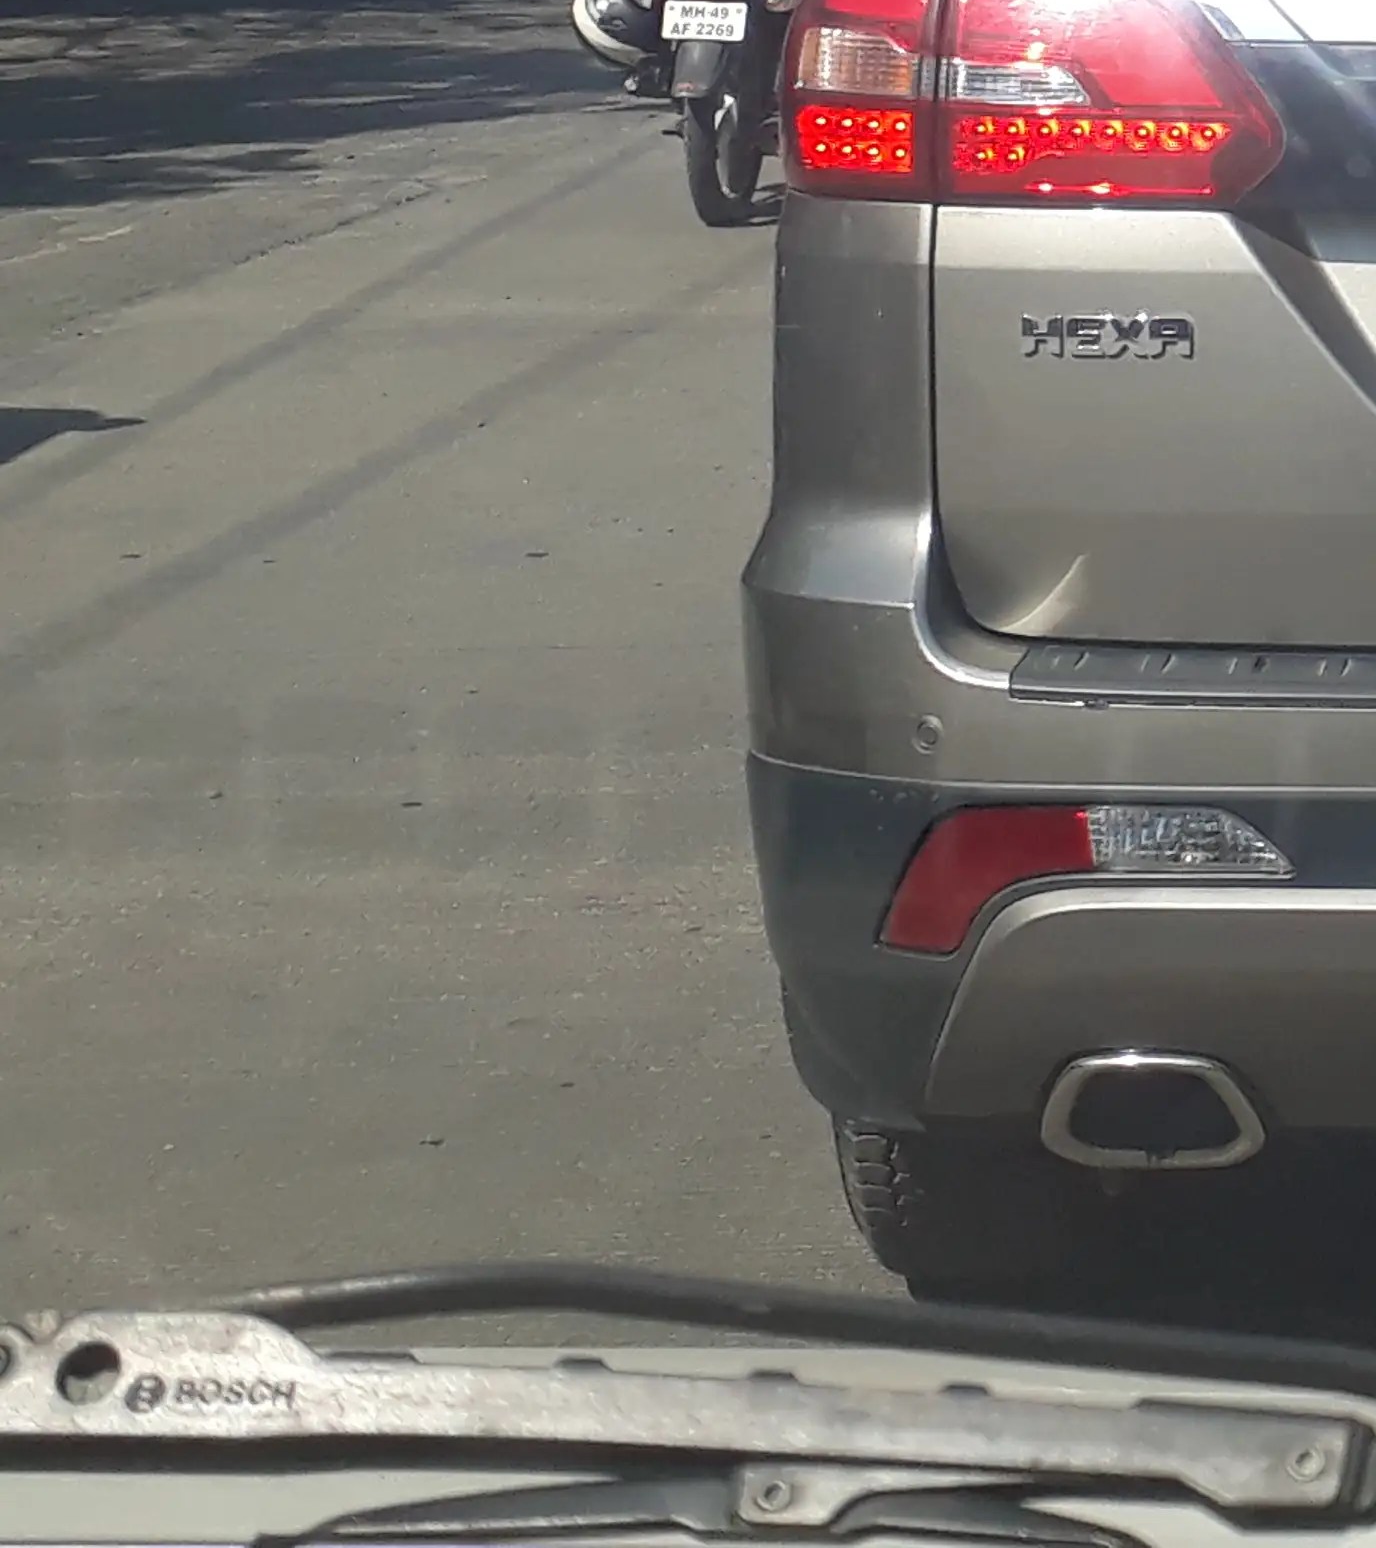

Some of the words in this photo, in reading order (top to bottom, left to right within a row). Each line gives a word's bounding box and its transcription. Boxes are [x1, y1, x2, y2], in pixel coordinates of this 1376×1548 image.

[670, 22, 691, 35] AF
[696, 22, 734, 37] 2269
[1021, 310, 1194, 359] HEXA
[176, 1377, 297, 1410] BOSCH
